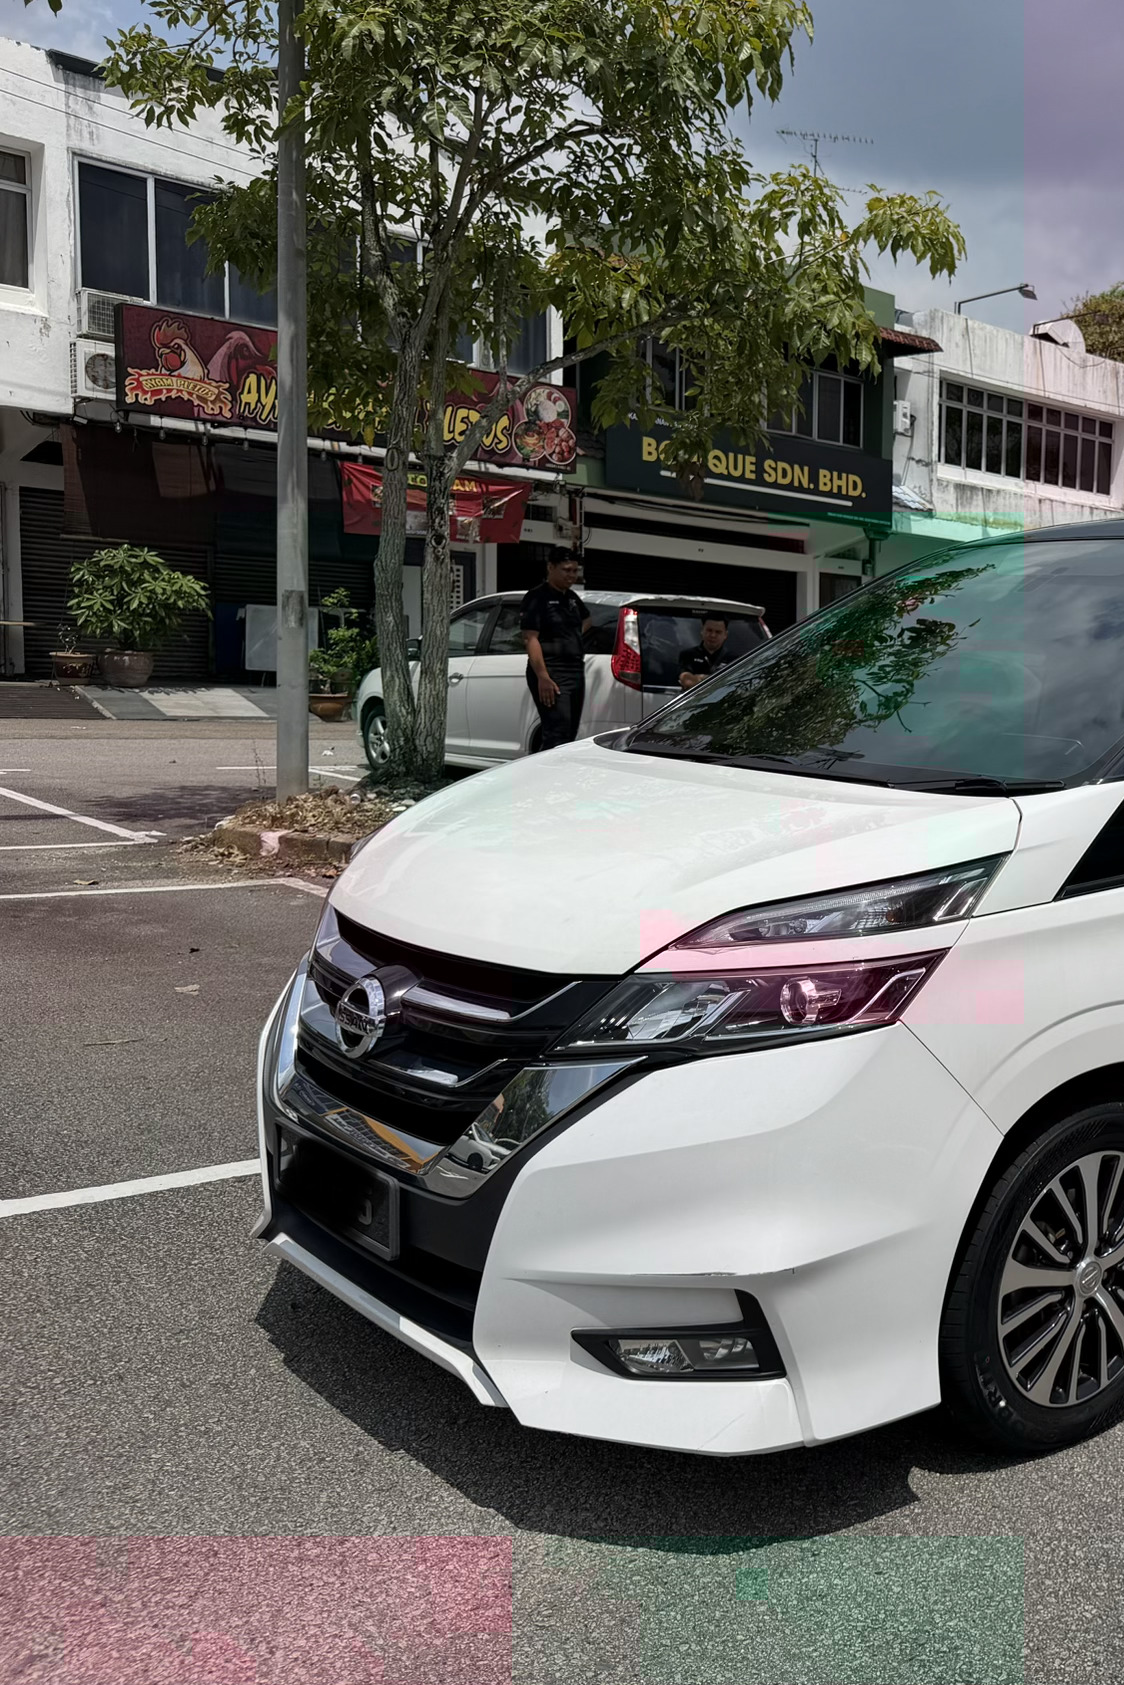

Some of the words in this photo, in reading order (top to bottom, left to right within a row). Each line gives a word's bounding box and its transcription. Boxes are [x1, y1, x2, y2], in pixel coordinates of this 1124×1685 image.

[142, 377, 174, 389] AYAM
[176, 378, 216, 398] PLETOS
[428, 401, 510, 450] LETS
[641, 436, 757, 480] BQUE
[763, 459, 815, 490] SDN.
[818, 468, 867, 498] BHD.
